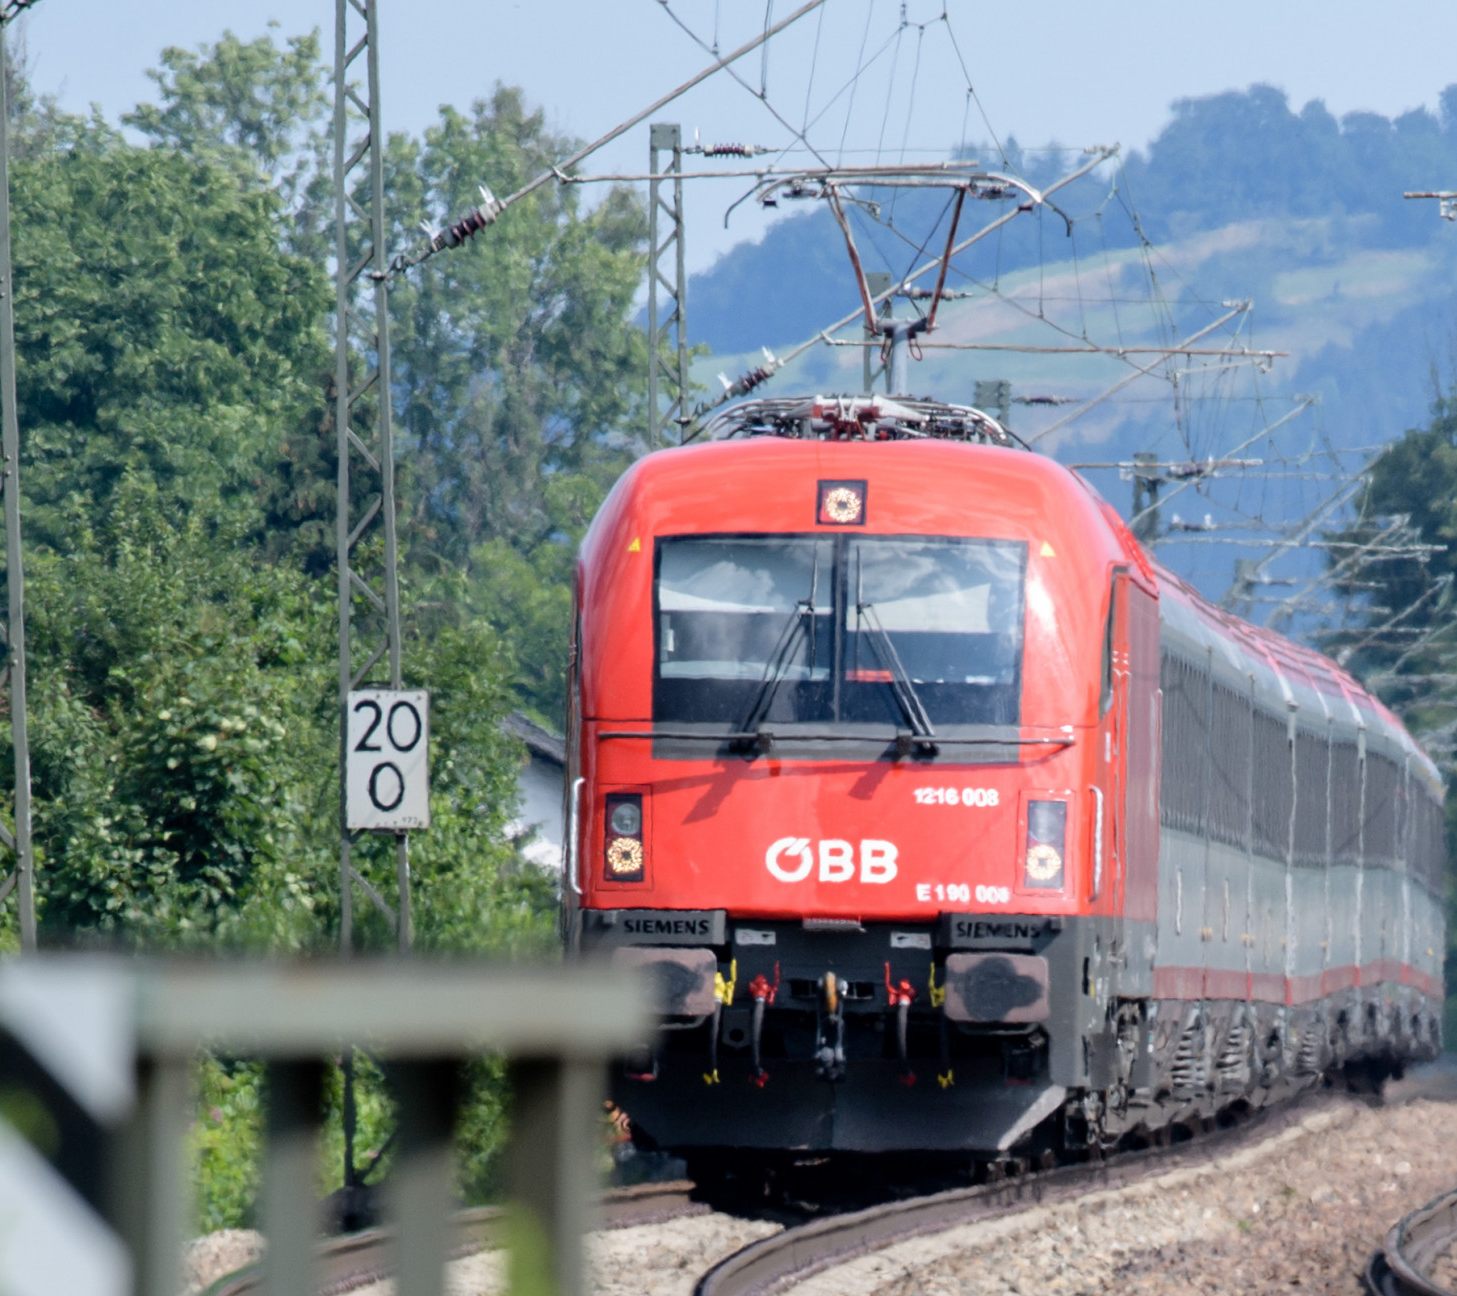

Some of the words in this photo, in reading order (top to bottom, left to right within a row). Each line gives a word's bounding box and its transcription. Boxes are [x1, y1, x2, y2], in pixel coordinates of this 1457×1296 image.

[353, 700, 422, 752] 20
[369, 762, 405, 812] 0
[913, 787, 959, 805] 1216
[962, 787, 999, 807] 008
[765, 836, 898, 883] ÖBB
[916, 883, 931, 902] E
[935, 883, 970, 903] 190
[624, 919, 709, 935] SIEMENS
[957, 921, 1041, 938] SIEMENS
